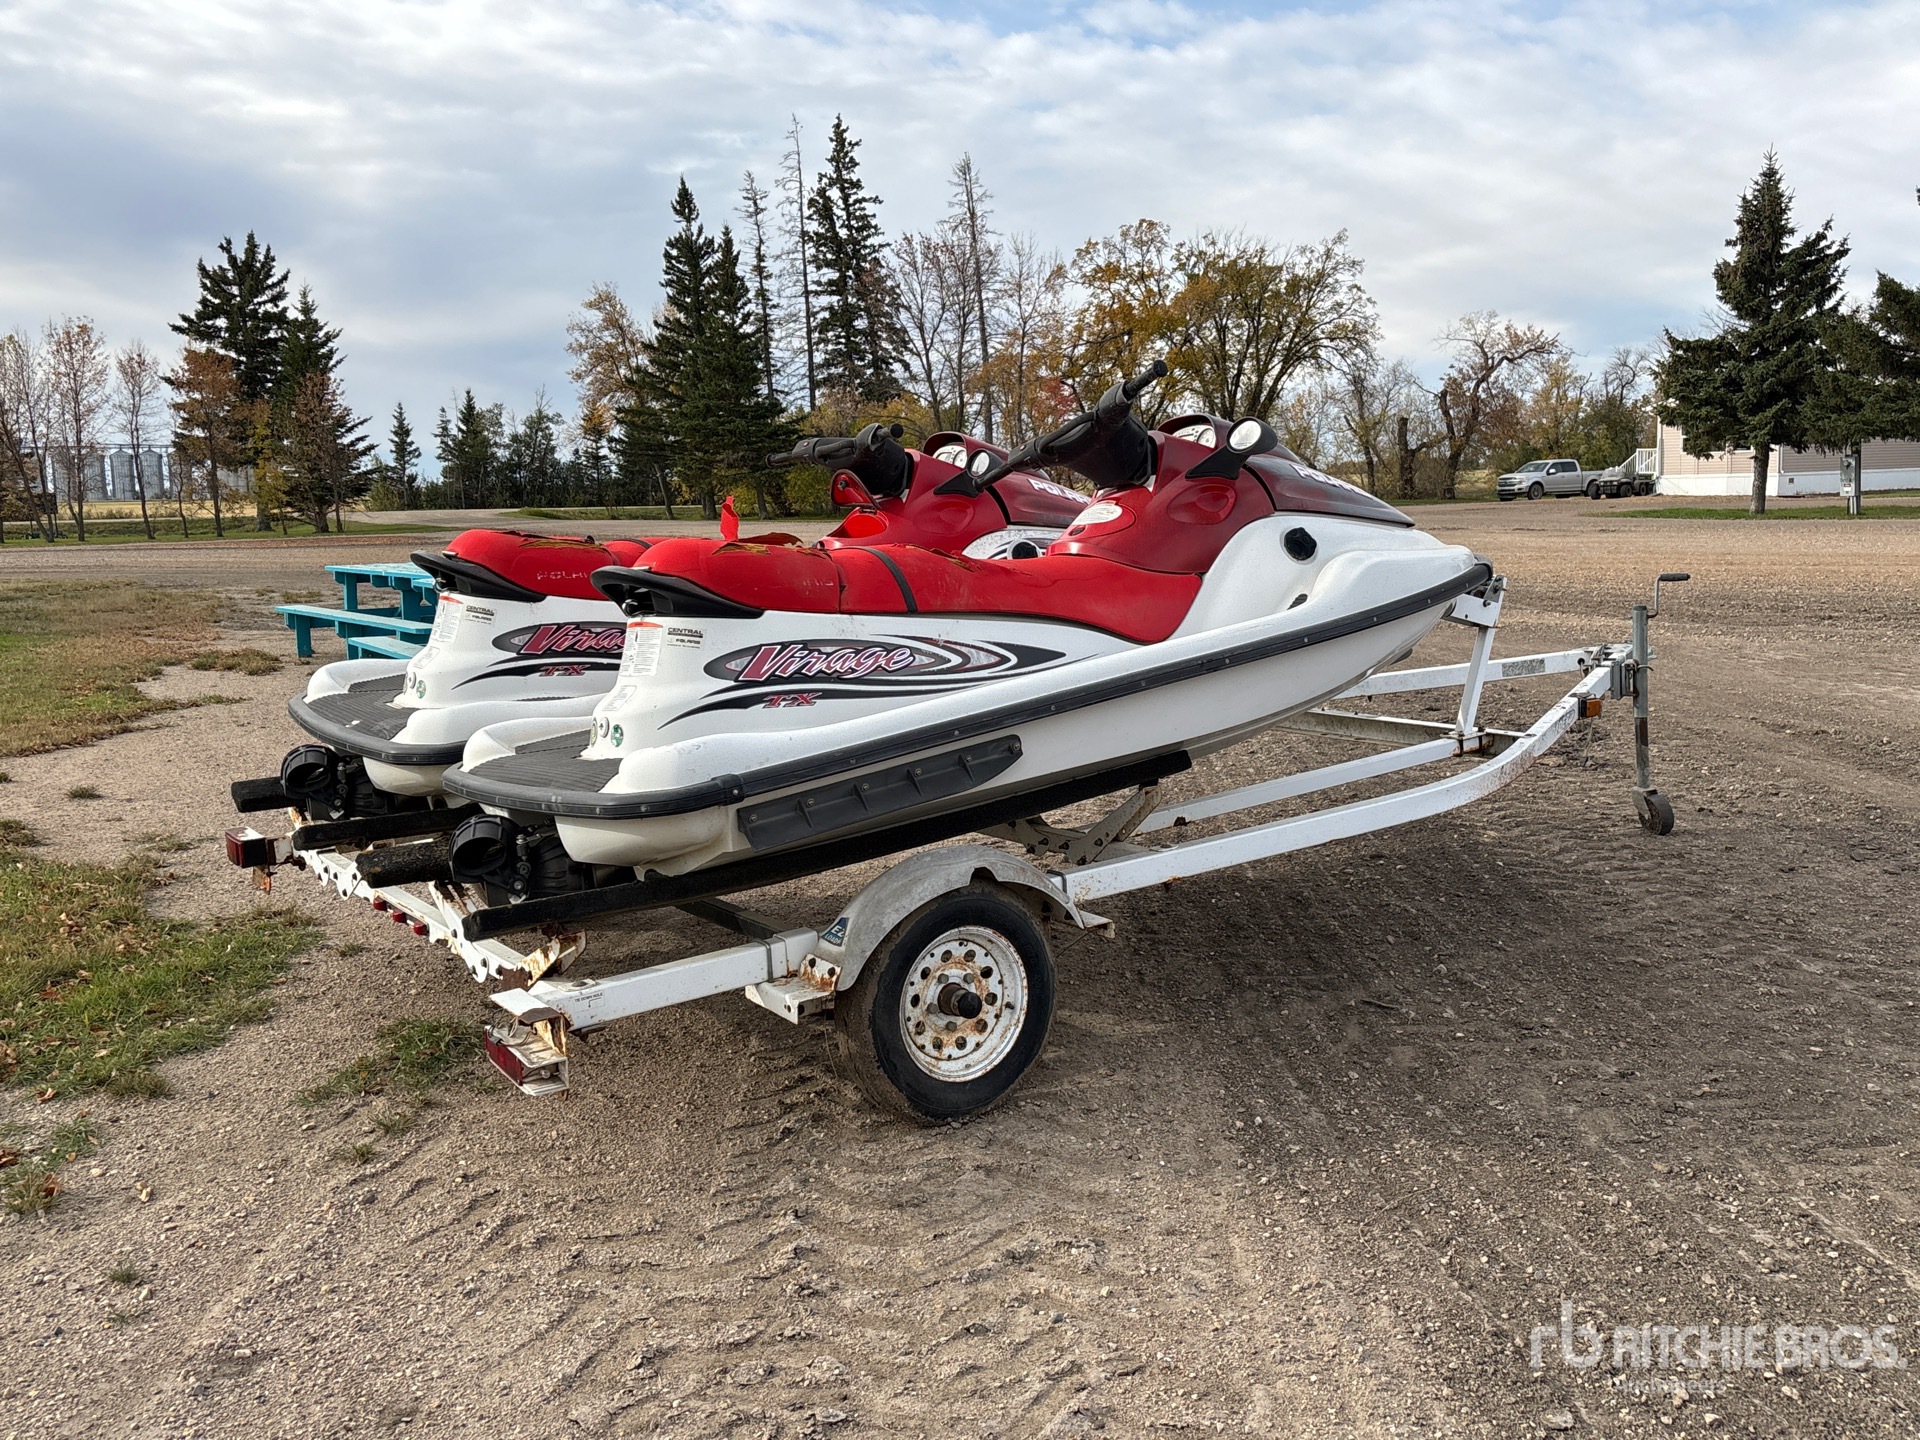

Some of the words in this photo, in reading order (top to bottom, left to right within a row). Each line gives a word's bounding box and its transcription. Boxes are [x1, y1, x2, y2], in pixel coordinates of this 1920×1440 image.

[1027, 478, 1091, 505] POLAR
[466, 605, 495, 614] CENTRAL
[520, 624, 627, 654] Vira
[667, 627, 704, 636] CENTRAL
[539, 664, 591, 677] TX
[737, 644, 914, 682] Virage
[763, 692, 823, 709] TX
